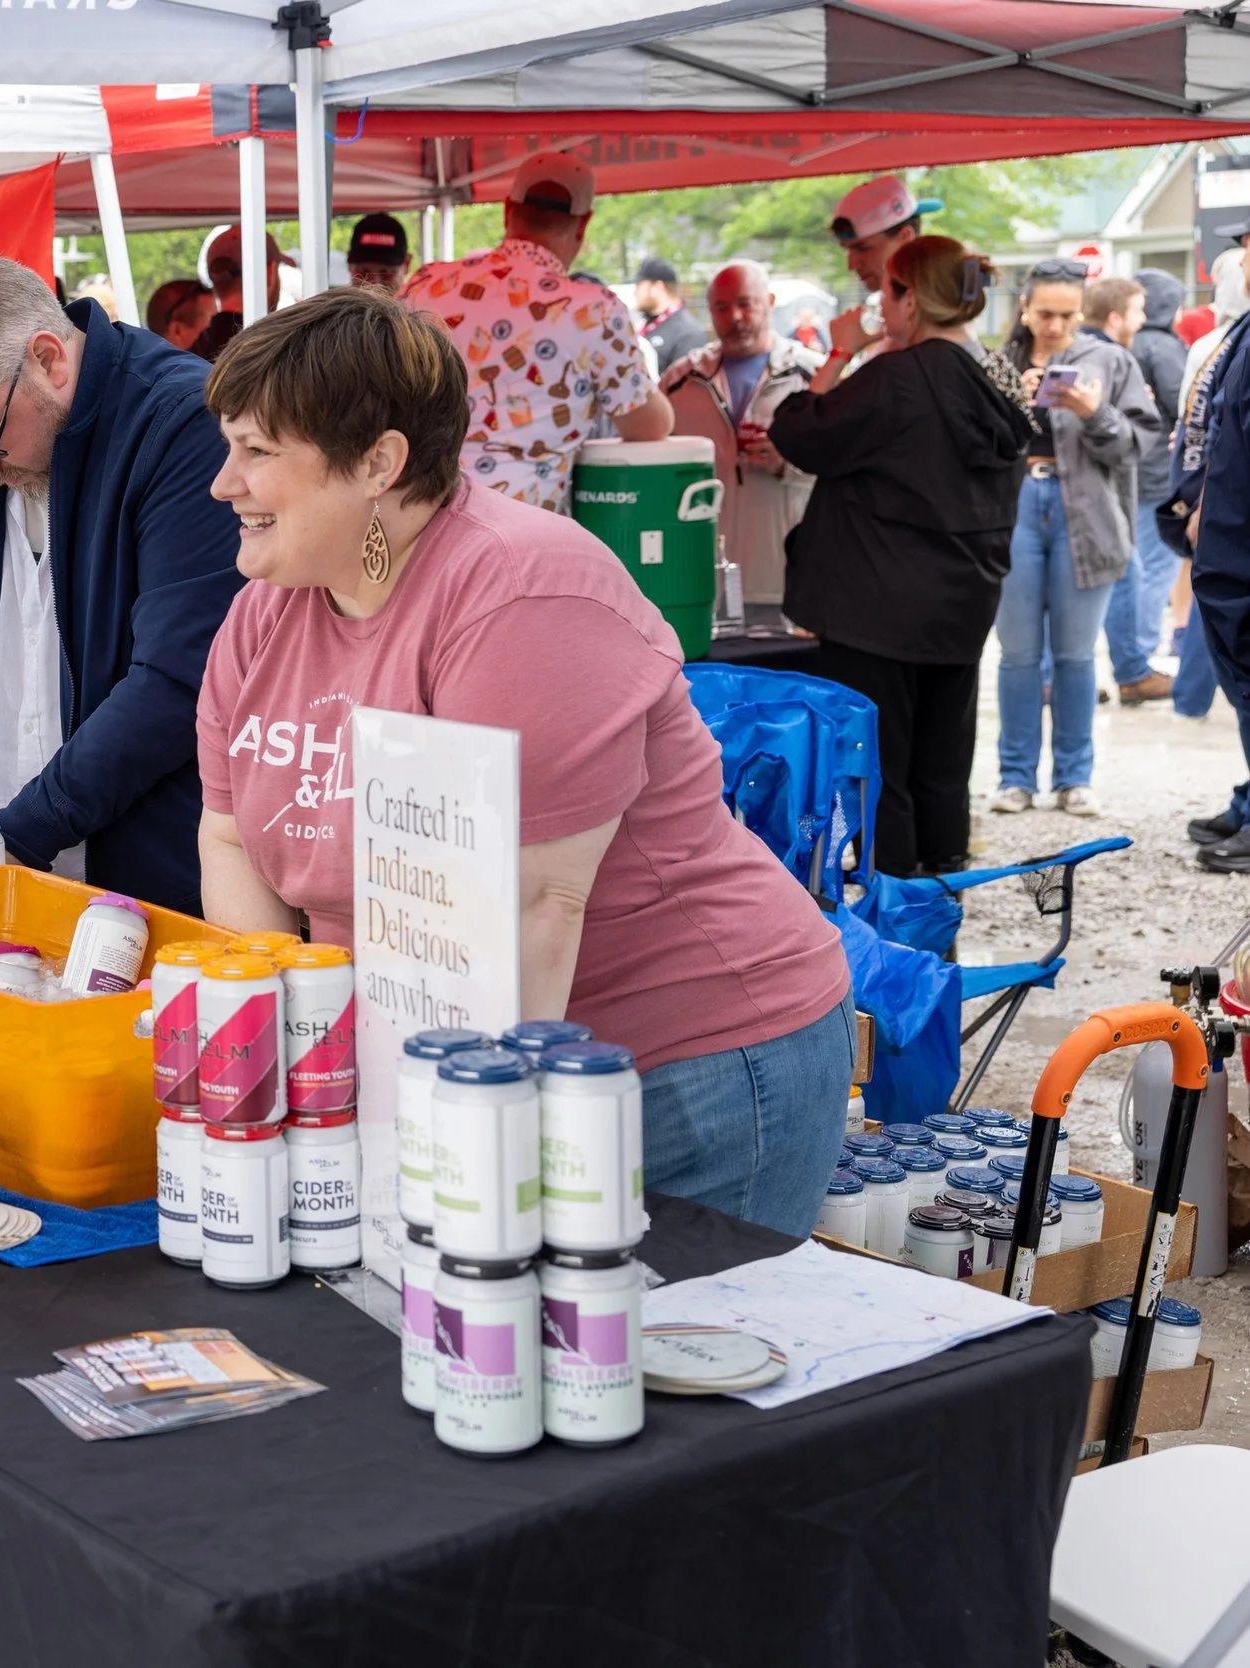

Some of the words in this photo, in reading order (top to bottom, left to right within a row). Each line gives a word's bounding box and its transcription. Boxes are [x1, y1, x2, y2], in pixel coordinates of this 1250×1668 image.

[229, 714, 343, 770] ASH
[295, 773, 322, 809] &
[366, 777, 447, 842] Crafted
[454, 799, 475, 850] in
[284, 823, 319, 840] CID
[367, 836, 454, 908] Indiana.
[367, 896, 471, 977] Delicious
[366, 970, 471, 1030] anywhere
[285, 1020, 328, 1036] ASH
[1123, 1019, 1169, 1040] COSCO
[290, 1071, 330, 1081] FLEETING
[211, 1084, 239, 1096] YOUTH
[1136, 1119, 1144, 1184] VEOR
[158, 1168, 173, 1186] ER
[292, 1180, 344, 1195] CIDER
[292, 1193, 355, 1211] MONTH
